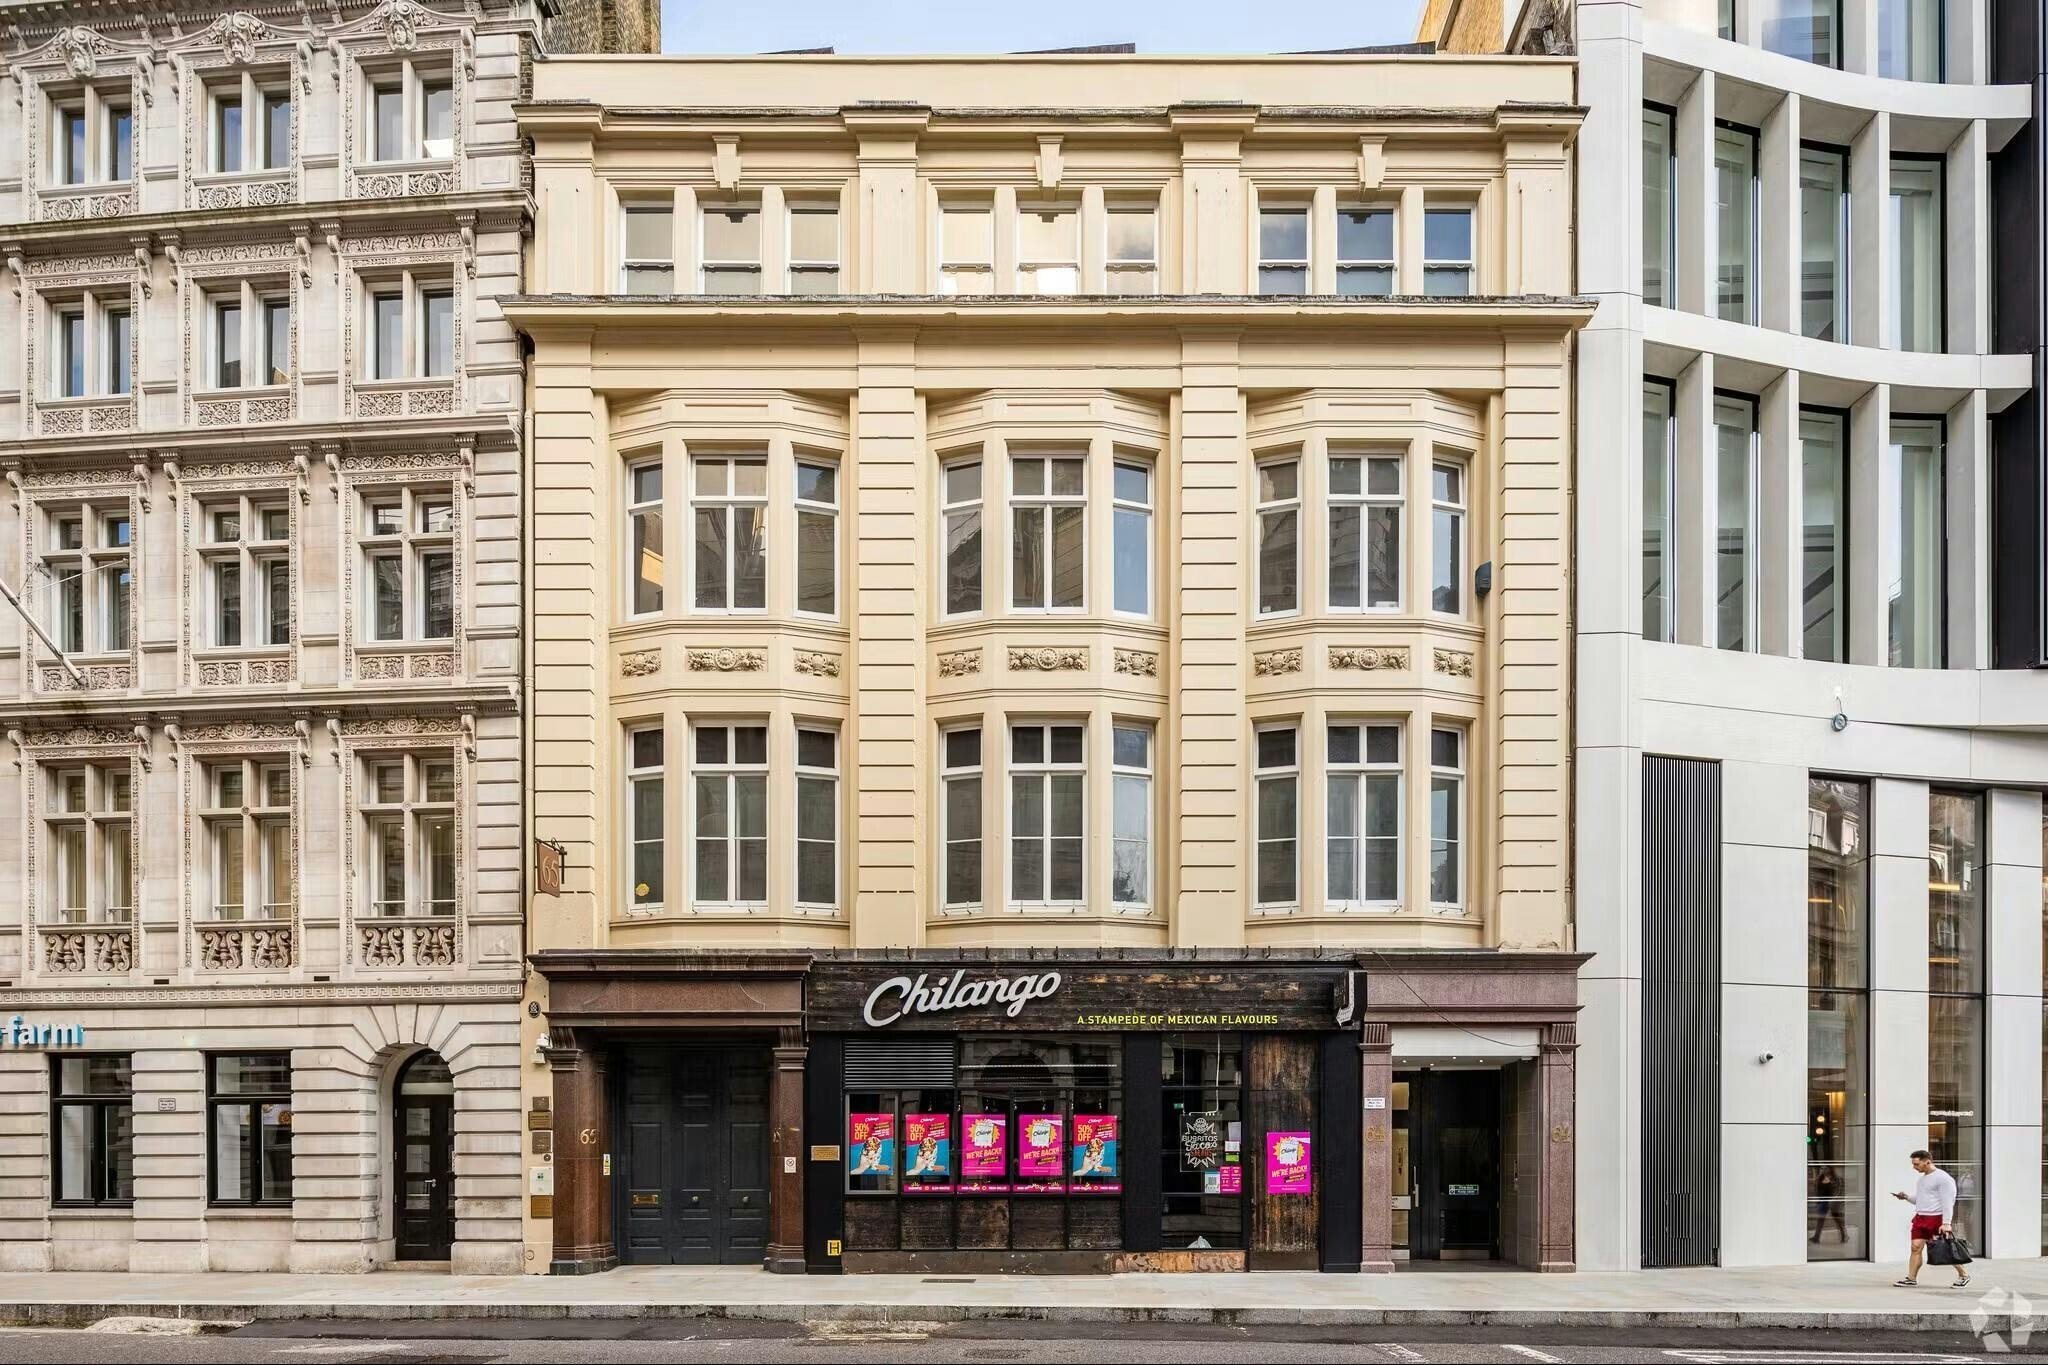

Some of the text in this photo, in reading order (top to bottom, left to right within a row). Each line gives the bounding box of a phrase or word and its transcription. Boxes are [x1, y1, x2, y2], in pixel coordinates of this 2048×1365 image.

[542, 855, 559, 888] 65
[863, 969, 1062, 1028] Chilango
[1077, 1015, 1278, 1025] A STAMPEDE OF MEXICAN FLAVOURS
[854, 1123, 869, 1132] 50%
[910, 1124, 925, 1133] 50%
[1077, 1124, 1093, 1133] 50%
[580, 1128, 597, 1144] 65
[854, 1132, 868, 1140] OFF
[910, 1133, 924, 1141] OFF
[1077, 1133, 1091, 1142] OFF
[829, 1243, 840, 1255] H
